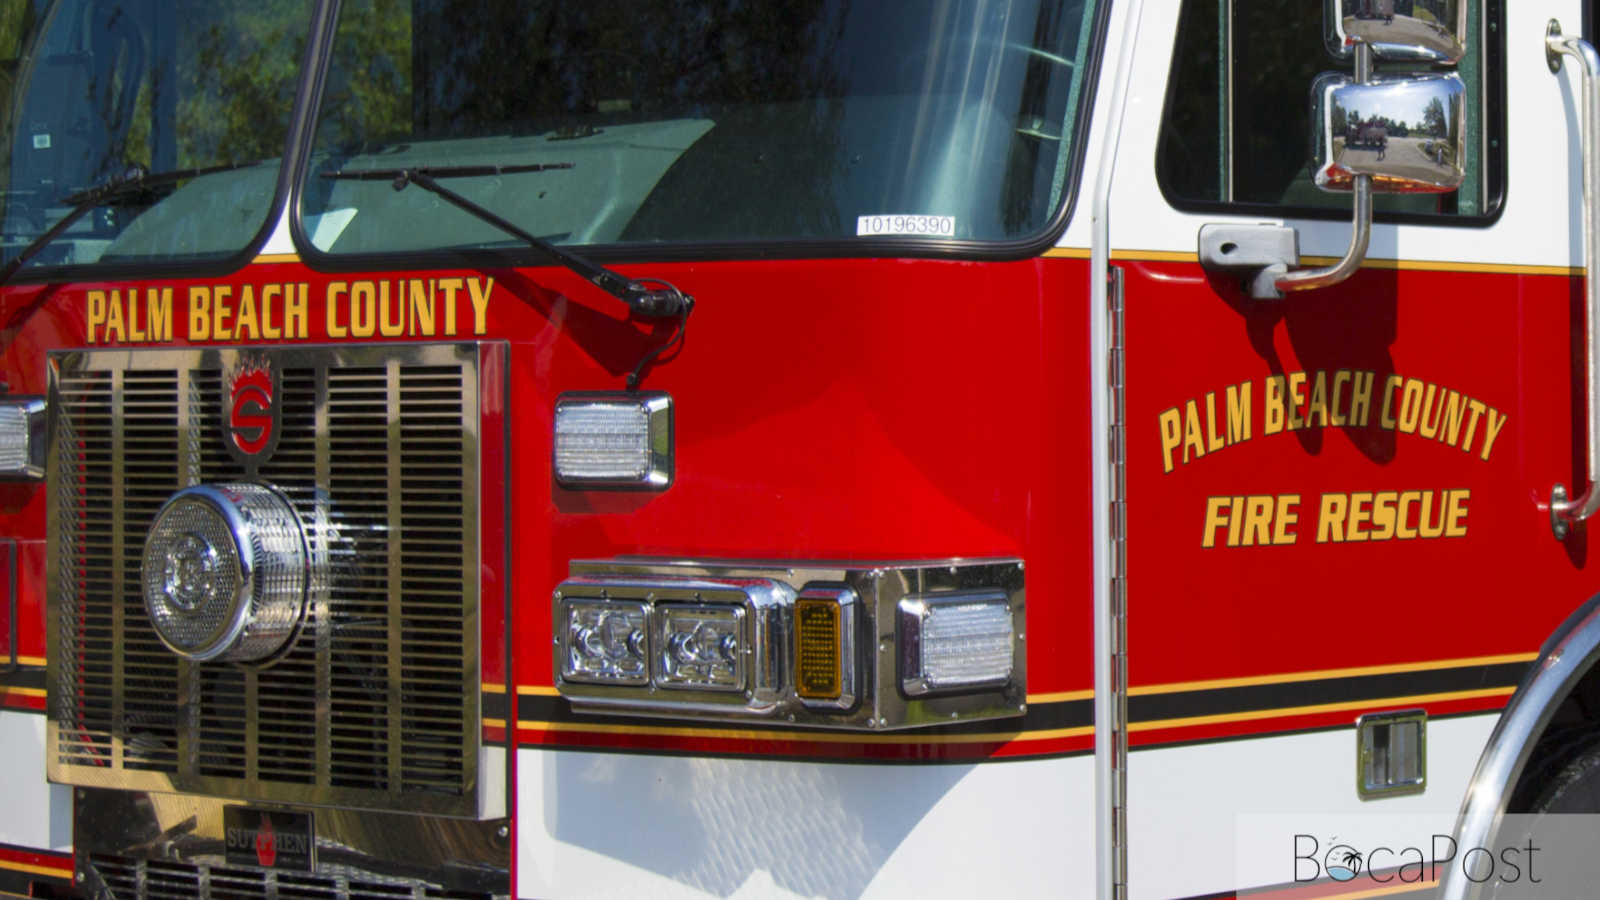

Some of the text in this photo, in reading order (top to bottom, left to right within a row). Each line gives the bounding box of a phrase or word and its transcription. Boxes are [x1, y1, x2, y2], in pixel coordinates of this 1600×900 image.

[864, 216, 952, 233] 10196390
[87, 276, 495, 343] PALM BEACH COUNTY
[1158, 370, 1508, 474] PALM BEACH COUNTY
[1201, 488, 1471, 549] FIRE RESCUE
